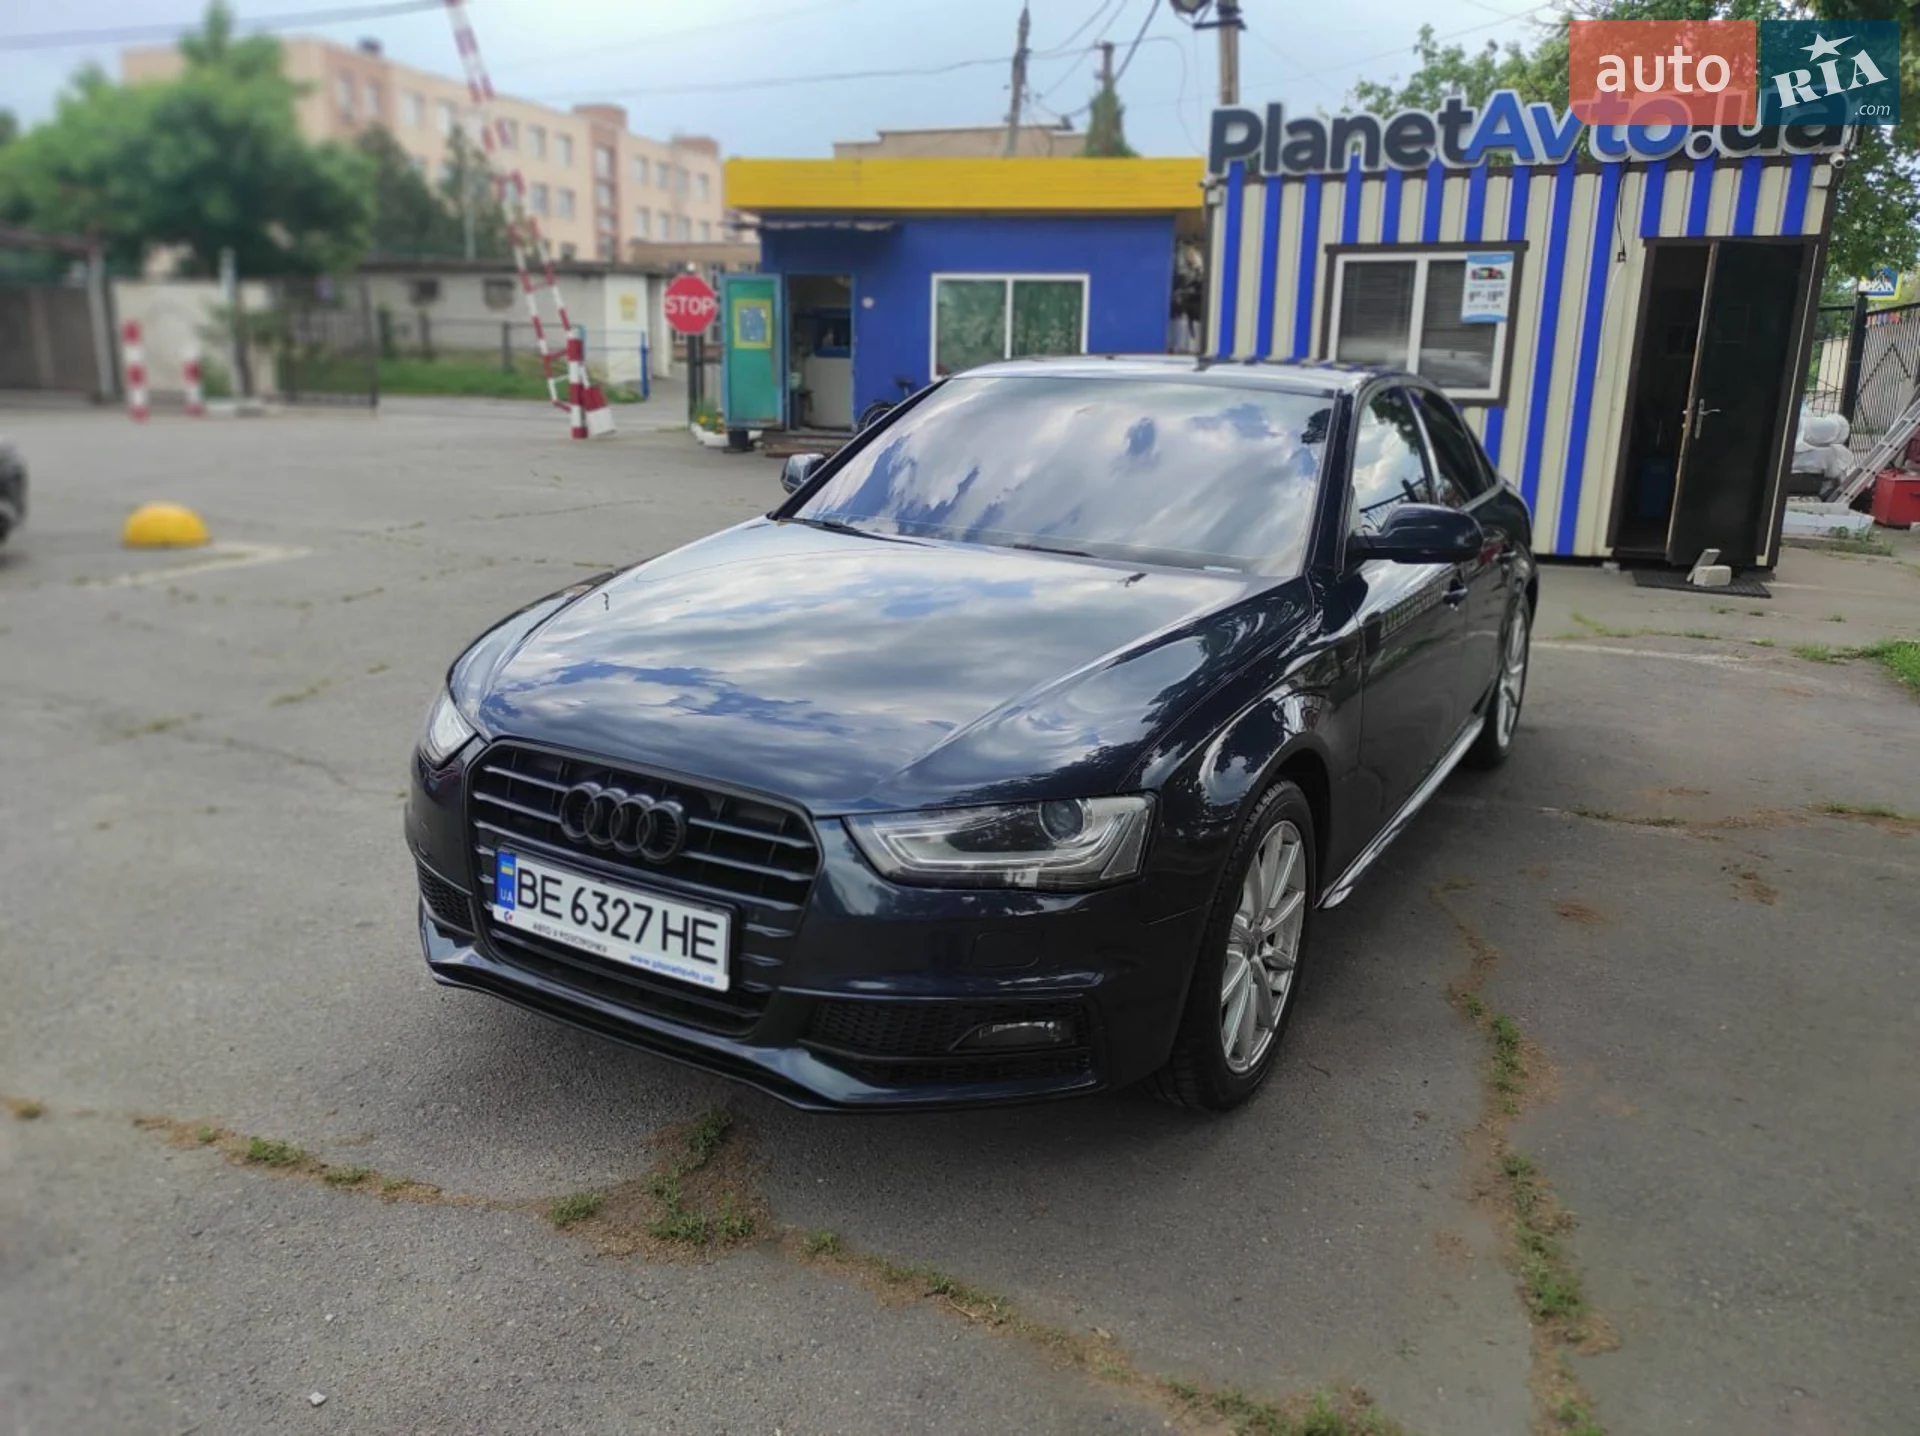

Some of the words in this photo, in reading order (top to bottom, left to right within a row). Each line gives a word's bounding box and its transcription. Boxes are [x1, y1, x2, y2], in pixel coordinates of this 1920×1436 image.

[665, 295, 717, 315] STOP
[500, 887, 514, 904] UA
[517, 867, 563, 920] BE
[570, 886, 653, 944] 6327
[661, 909, 719, 965] HE
